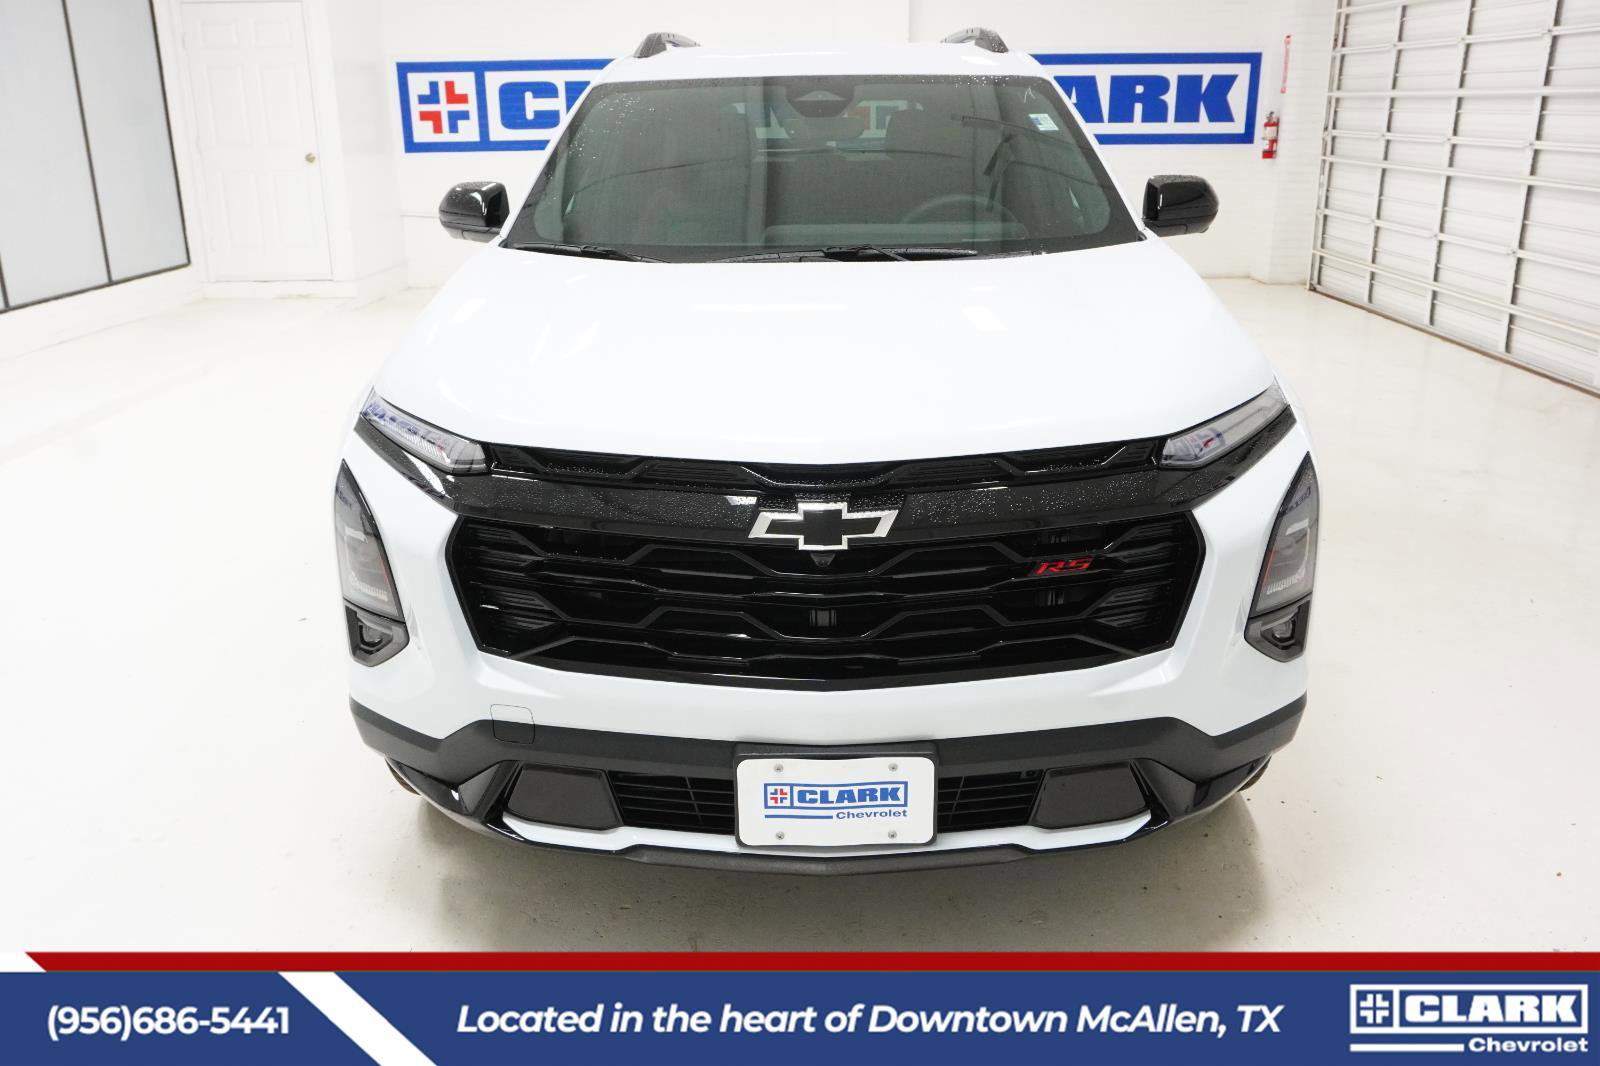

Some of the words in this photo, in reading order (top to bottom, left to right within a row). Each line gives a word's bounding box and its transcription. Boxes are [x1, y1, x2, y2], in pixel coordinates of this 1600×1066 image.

[1035, 555, 1093, 575] RS
[797, 787, 900, 804] CLARK
[836, 809, 908, 820] Chevrolet
